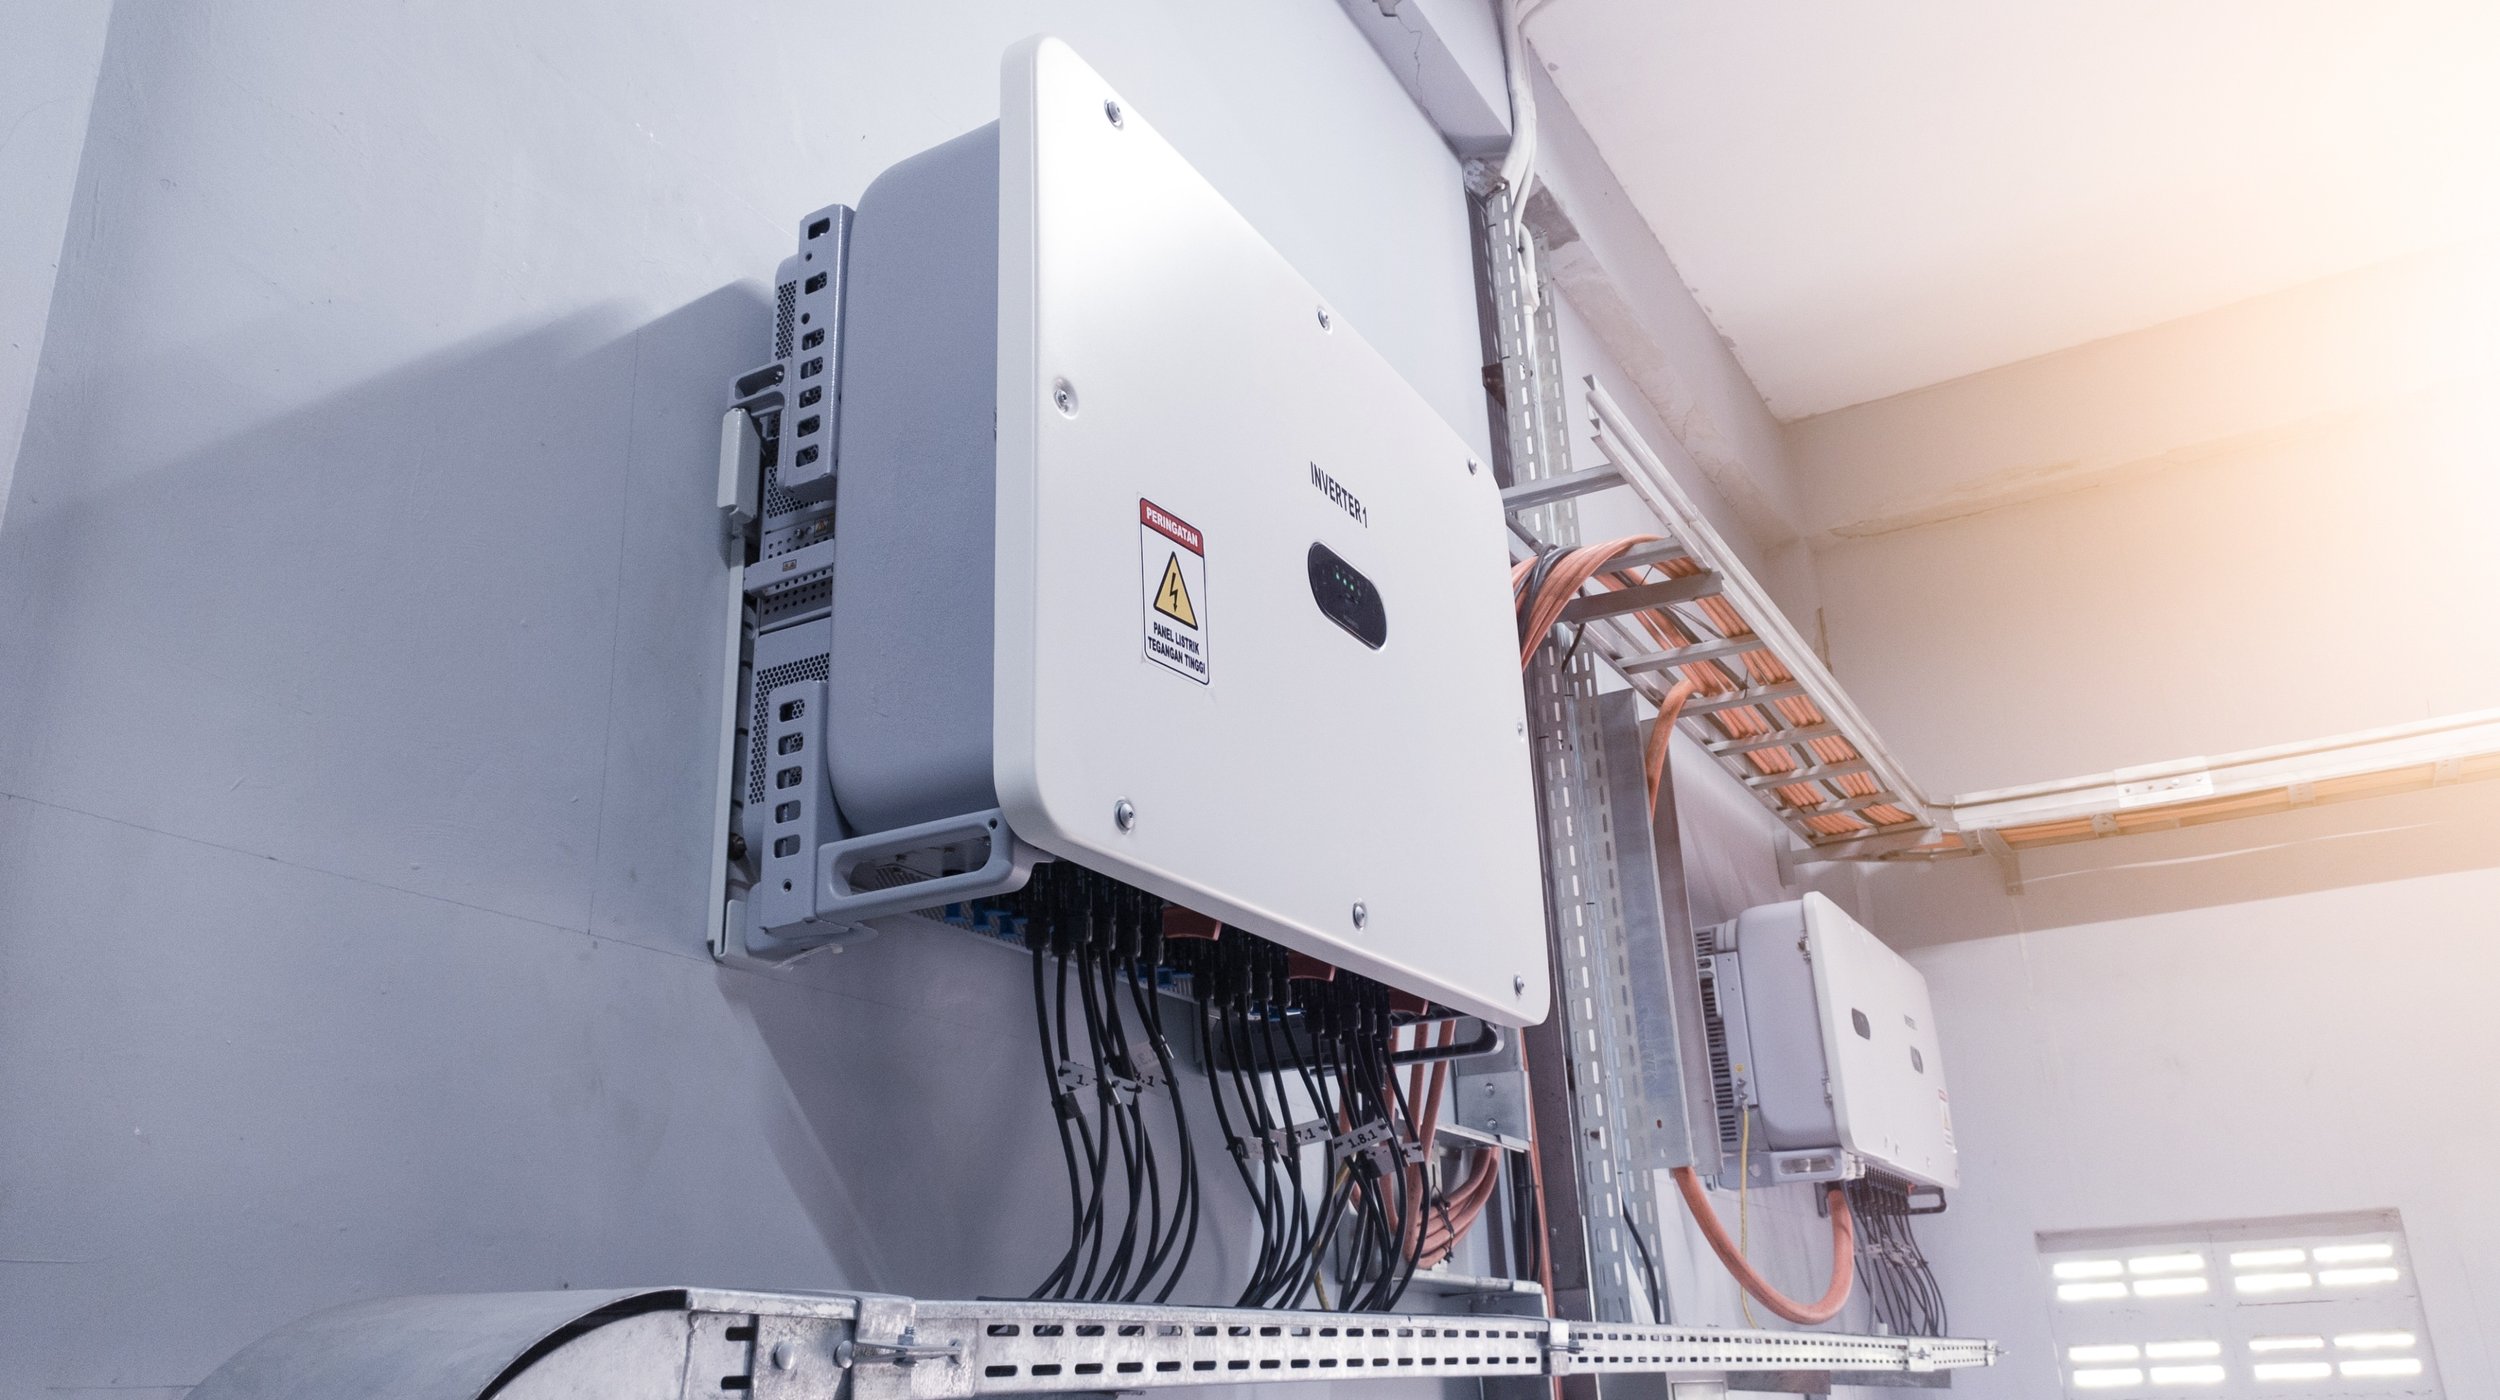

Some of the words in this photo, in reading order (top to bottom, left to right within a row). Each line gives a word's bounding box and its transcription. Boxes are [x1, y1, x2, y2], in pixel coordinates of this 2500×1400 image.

[1310, 461, 1362, 523] INVERTER
[1362, 506, 1368, 528] 1
[1146, 506, 1198, 547] PERINGATAN
[1147, 636, 1183, 664] TEGANGAN
[1184, 653, 1206, 675] TINGGI
[1153, 621, 1174, 643] PANEL
[1175, 632, 1200, 655] LISTRIK
[1348, 1129, 1377, 1148] 1.8.1
